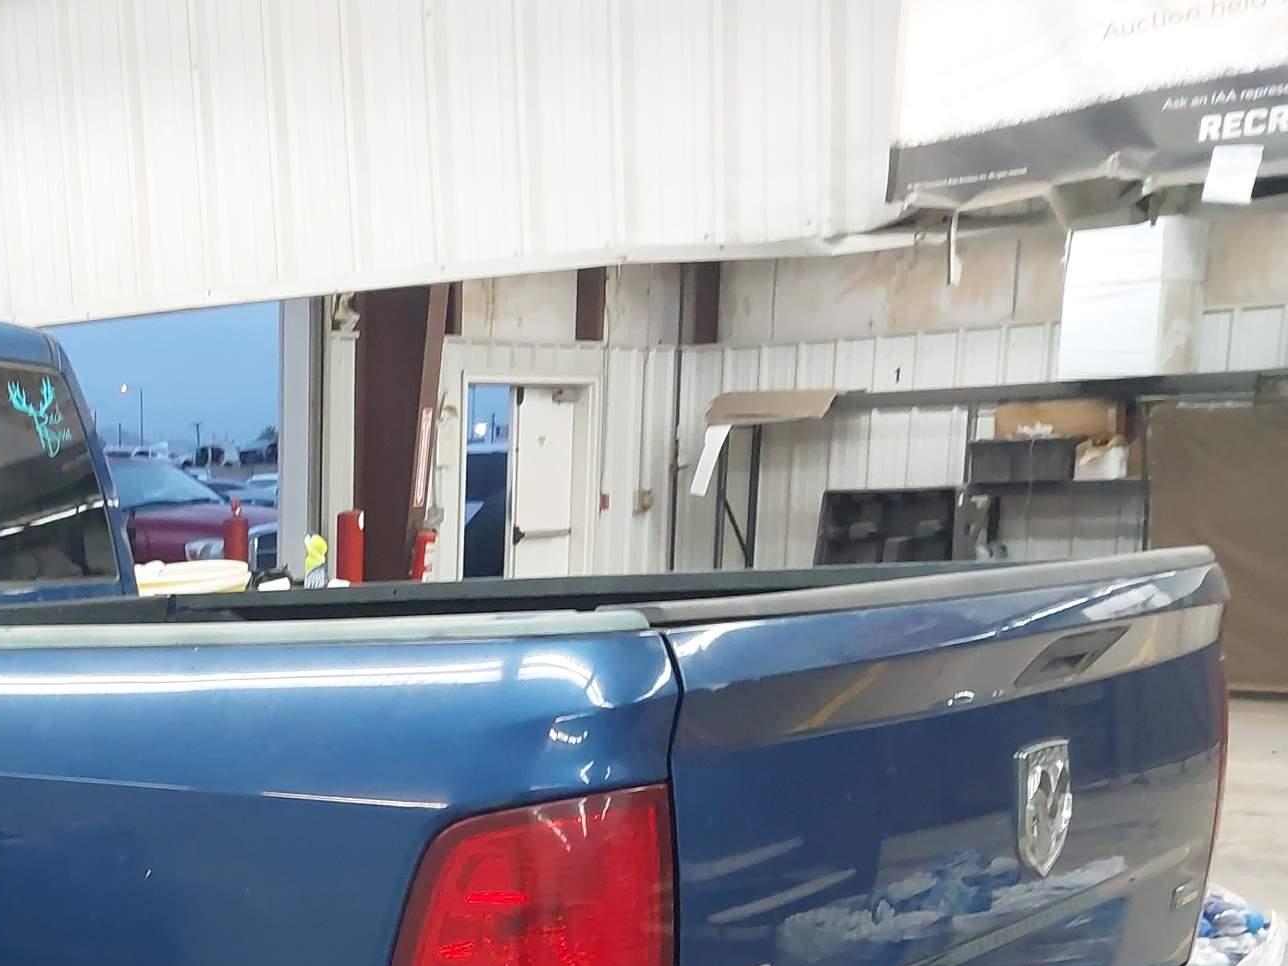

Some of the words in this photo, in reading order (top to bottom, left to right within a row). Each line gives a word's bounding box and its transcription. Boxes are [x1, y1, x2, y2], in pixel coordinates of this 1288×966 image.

[1102, 6, 1200, 41] Auction
[1161, 95, 1189, 112] Ask
[1190, 94, 1208, 108] an
[1210, 88, 1237, 105] IAA
[1198, 104, 1288, 143] RECR
